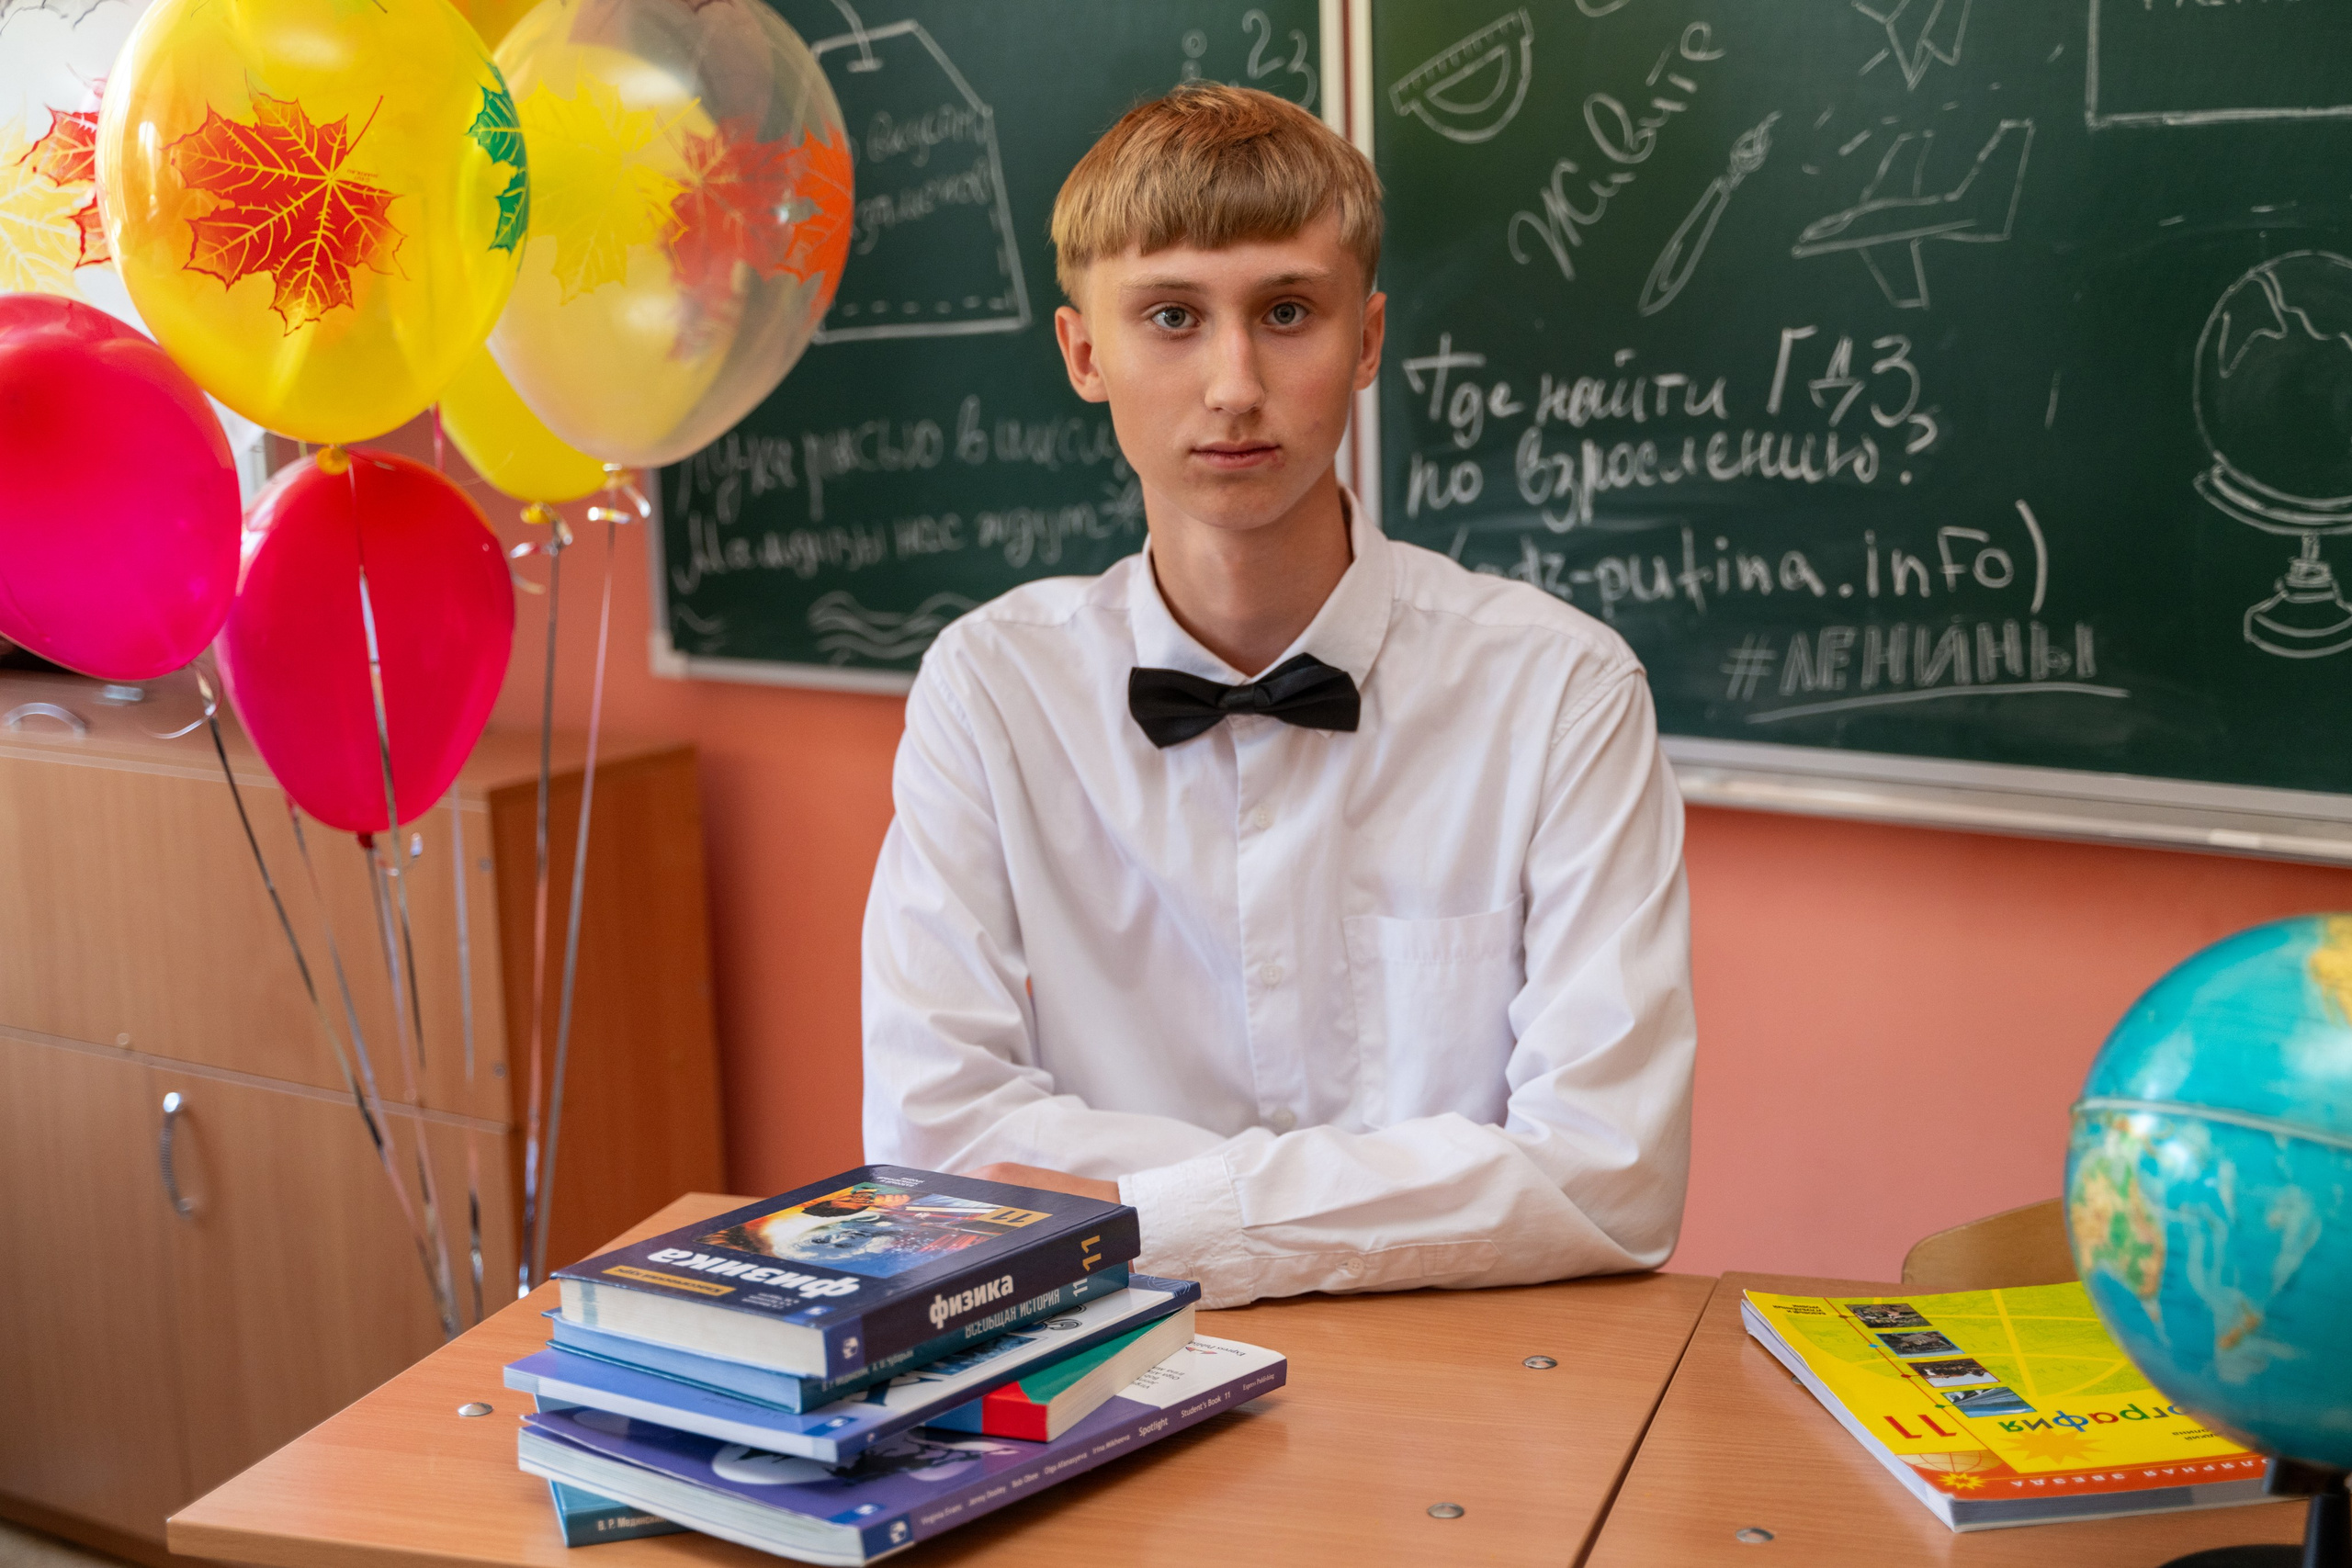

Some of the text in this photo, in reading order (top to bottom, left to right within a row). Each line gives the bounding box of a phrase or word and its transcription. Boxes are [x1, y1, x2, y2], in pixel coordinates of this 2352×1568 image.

[1535, 348, 1730, 428] найти
[1406, 452, 1483, 519] по
[989, 1210, 1033, 1224] 11
[1081, 1235, 1102, 1271] 11
[647, 1247, 861, 1299] физика
[929, 1274, 1014, 1330] физика
[1020, 1288, 1060, 1315] ИСТОРИЯ
[1242, 1372, 1275, 1392] Express Publishing
[1181, 1391, 1231, 1417] Student's Book 11
[1997, 1403, 2187, 1433] ография
[1138, 1416, 1169, 1437] Spotlight
[1883, 1413, 1958, 1439] 11
[2010, 1457, 2270, 1488] ЛЯРНАЯ ЗВЕЗДА
